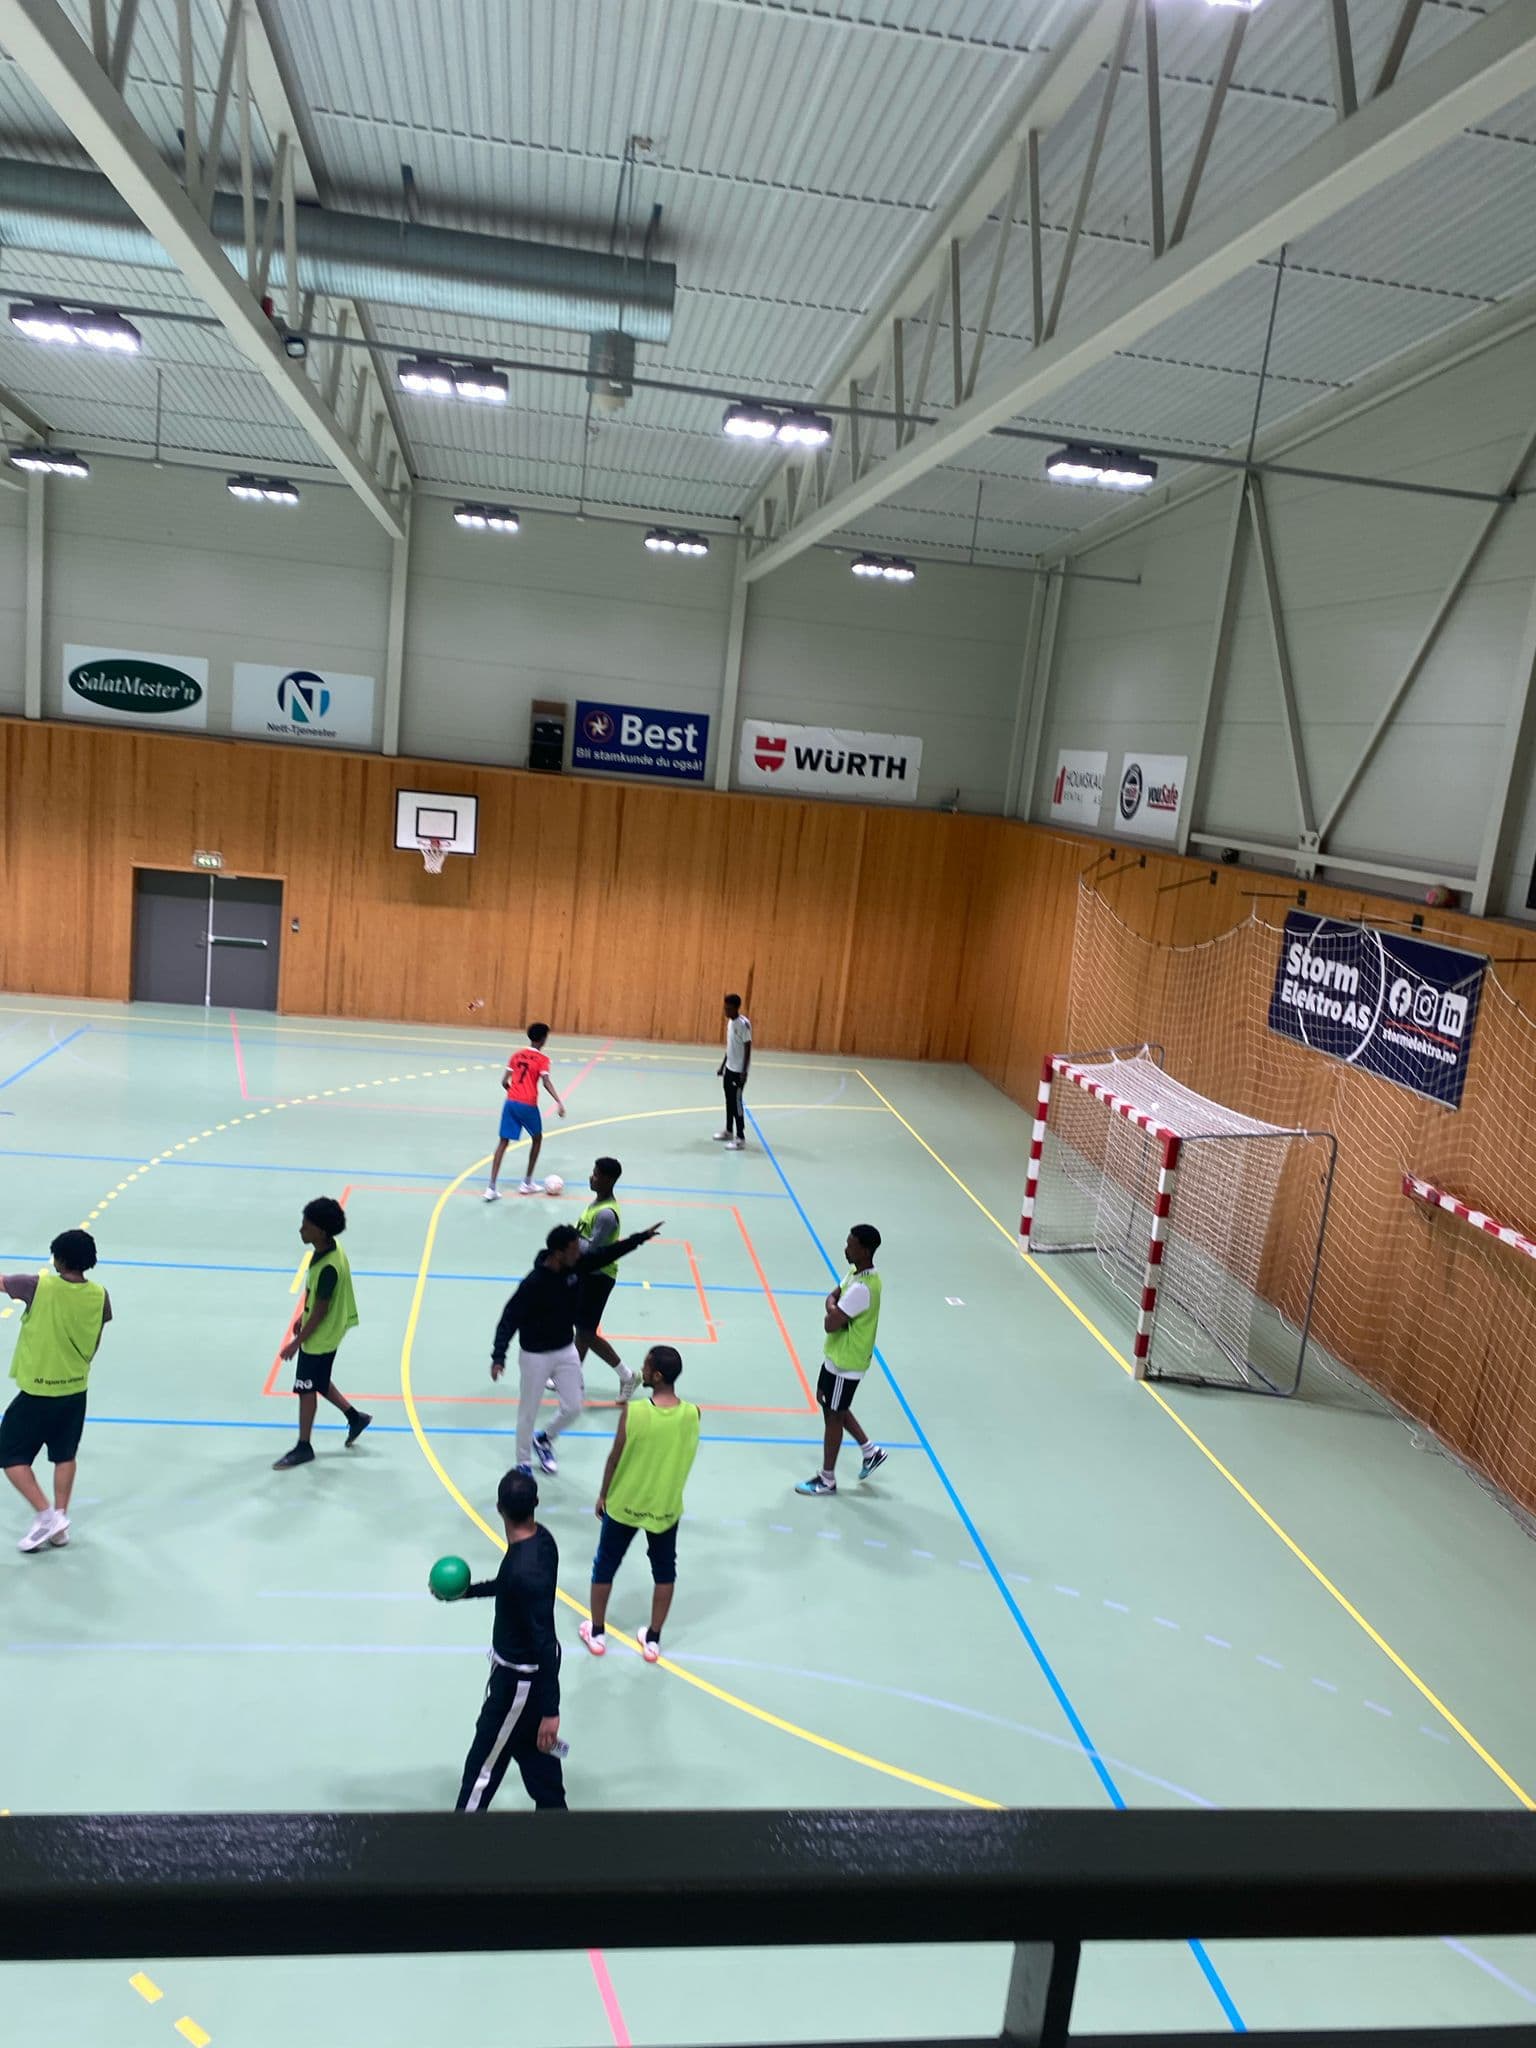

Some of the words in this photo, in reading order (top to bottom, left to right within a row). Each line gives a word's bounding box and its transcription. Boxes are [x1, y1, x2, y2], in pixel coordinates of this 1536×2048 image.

[76, 670, 196, 701] SalatMester'n
[620, 713, 699, 754] Best
[576, 747, 591, 760] Bli
[593, 750, 654, 766] stamkunde
[656, 757, 671, 768] du
[794, 746, 907, 780] WÜRTH
[1287, 942, 1359, 995] Storm
[1281, 978, 1343, 1022] Elektro
[1341, 1000, 1372, 1032] AS
[1382, 1028, 1457, 1066] stormelektro.no
[517, 1061, 529, 1084] 7
